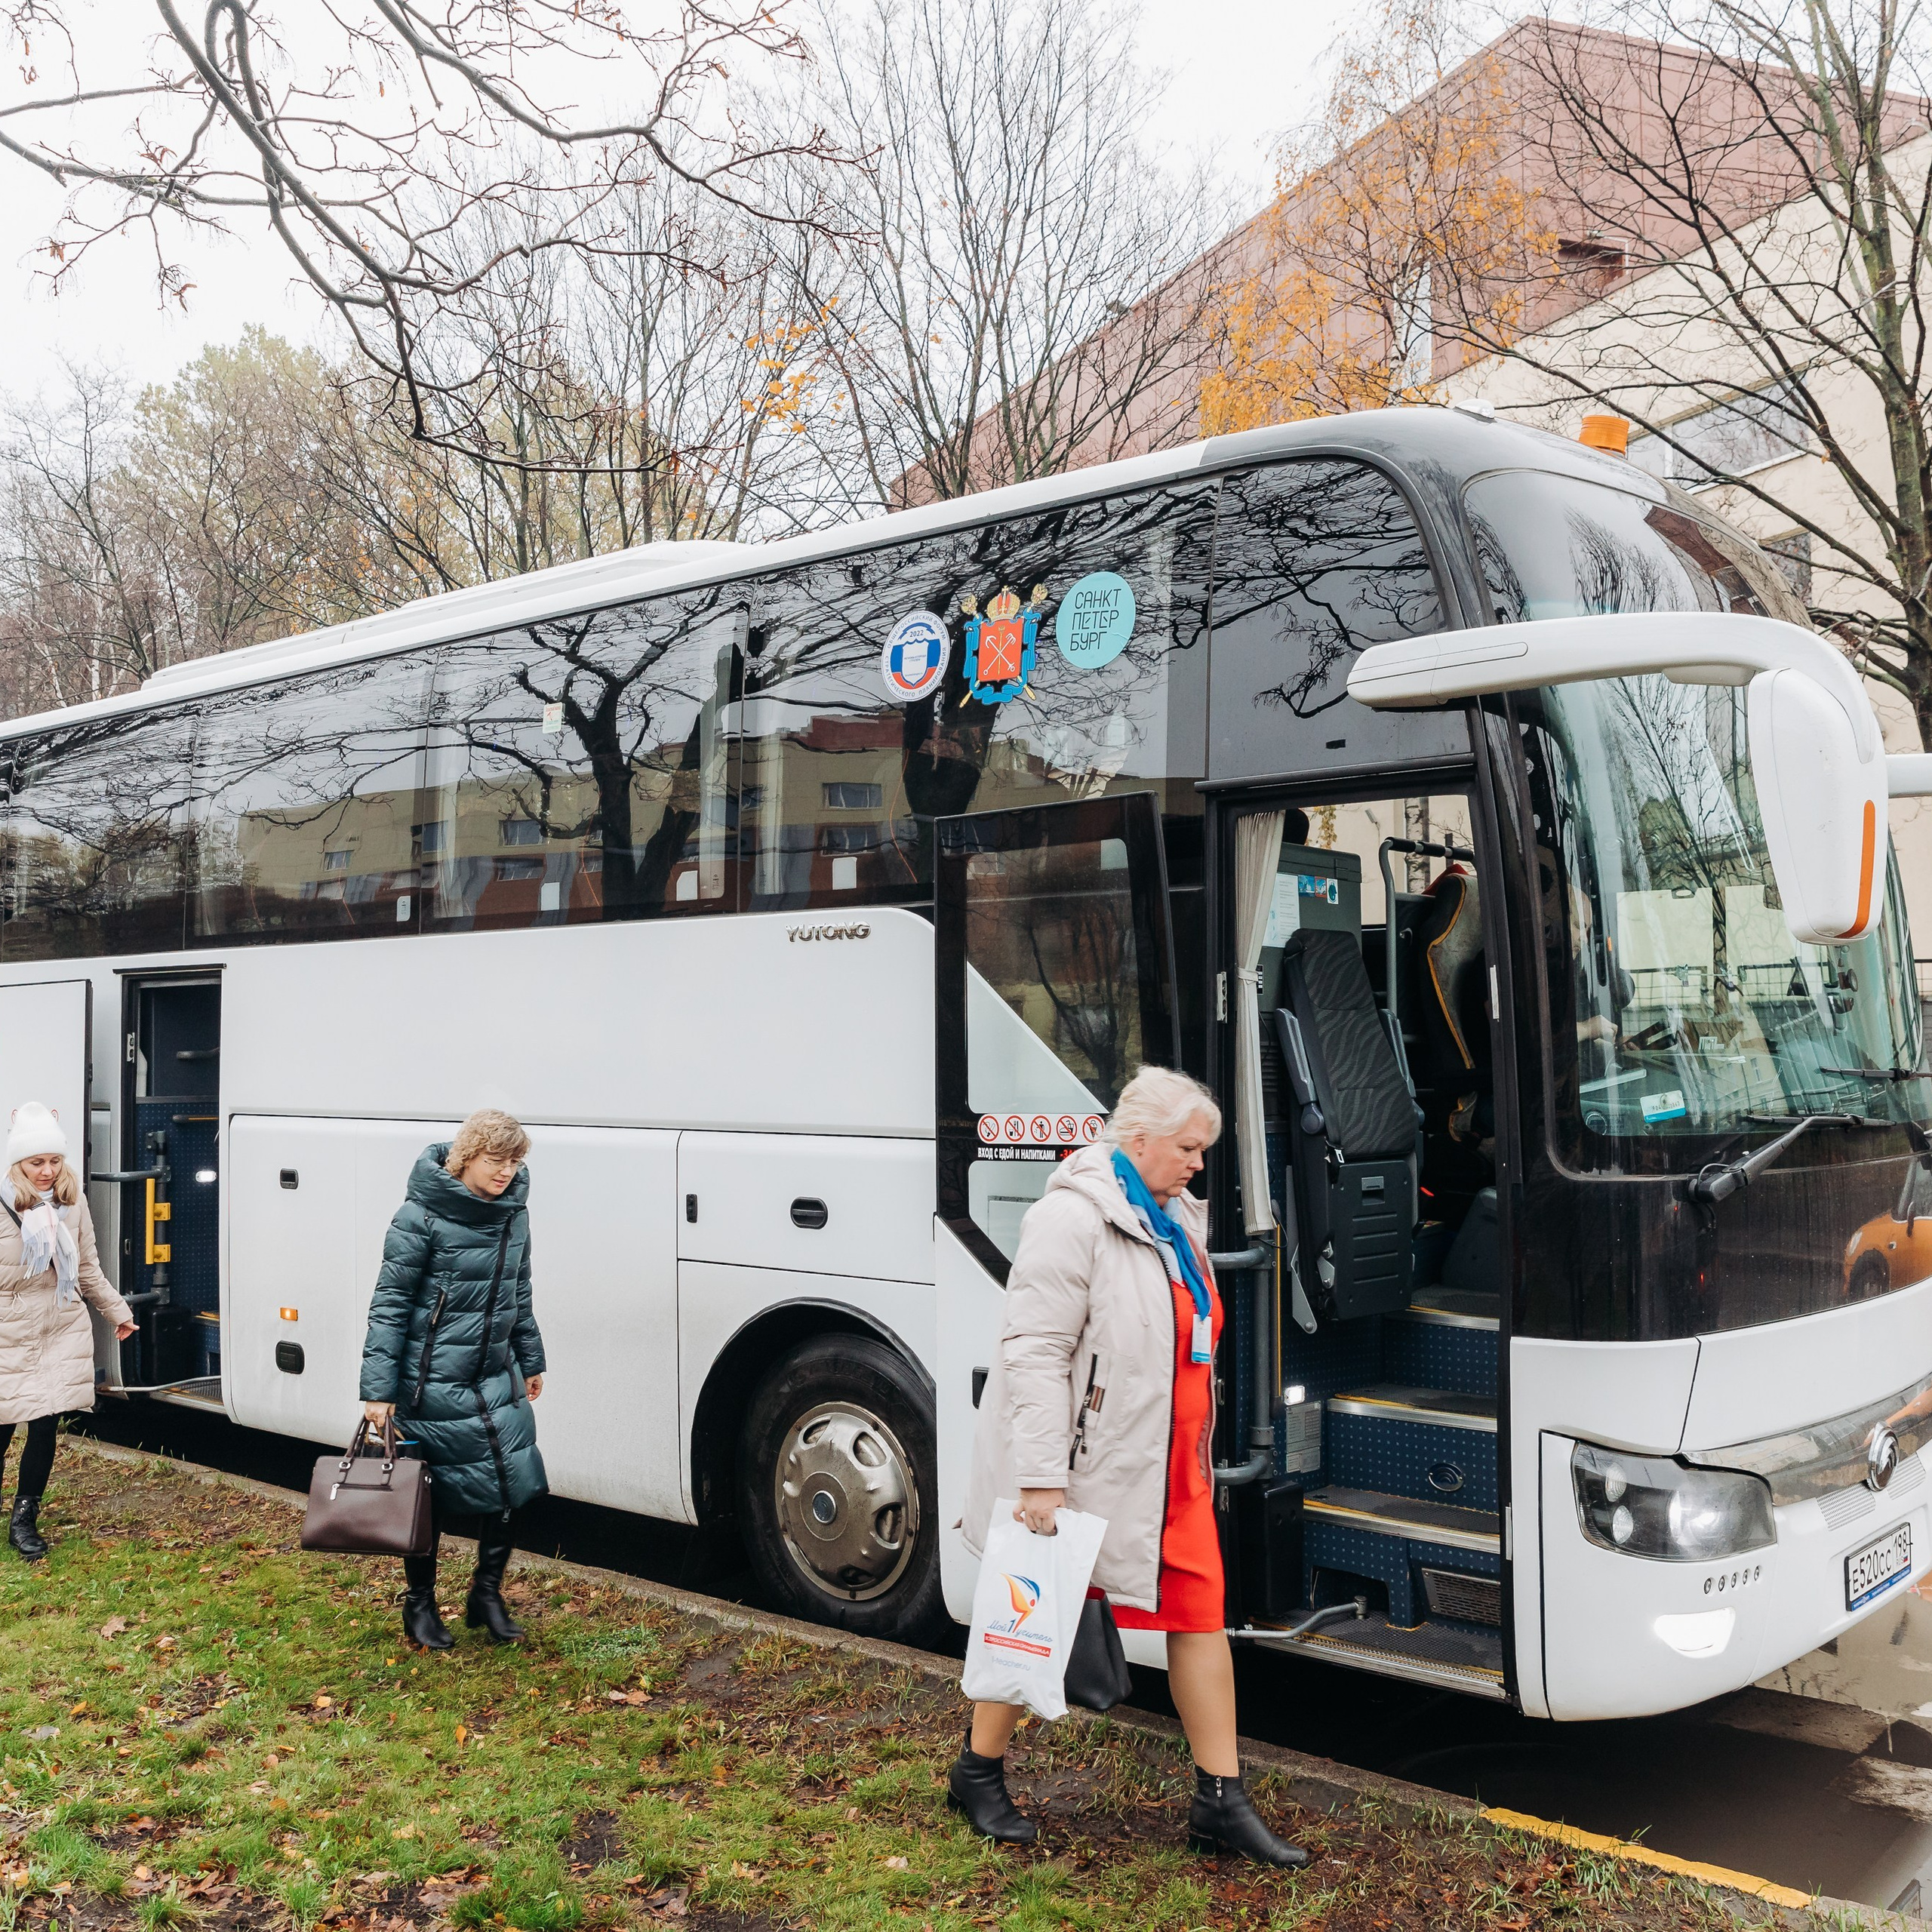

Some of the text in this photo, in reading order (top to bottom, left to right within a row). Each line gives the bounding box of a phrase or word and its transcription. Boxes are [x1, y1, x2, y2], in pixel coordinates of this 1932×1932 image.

[1075, 589, 1121, 609] САНКТ
[1072, 610, 1119, 630] ПЕТЕР
[888, 615, 946, 648] ОБЩЕРОССИЙСКИЙ ФОРУМ
[1070, 632, 1107, 651] БУРГ
[885, 647, 946, 697] СТРАТЕГИЧЕСКОГО ПЛАНИРОВАНИЯ
[786, 921, 872, 943] YUTONG
[977, 1147, 993, 1160] ВХОД
[994, 1148, 998, 1158] С
[999, 1146, 1014, 1161] ЕДОЙ
[1015, 1149, 1020, 1159] И
[1020, 1149, 1056, 1161] НАПИТКАМИ
[1894, 1531, 1907, 1558] 198
